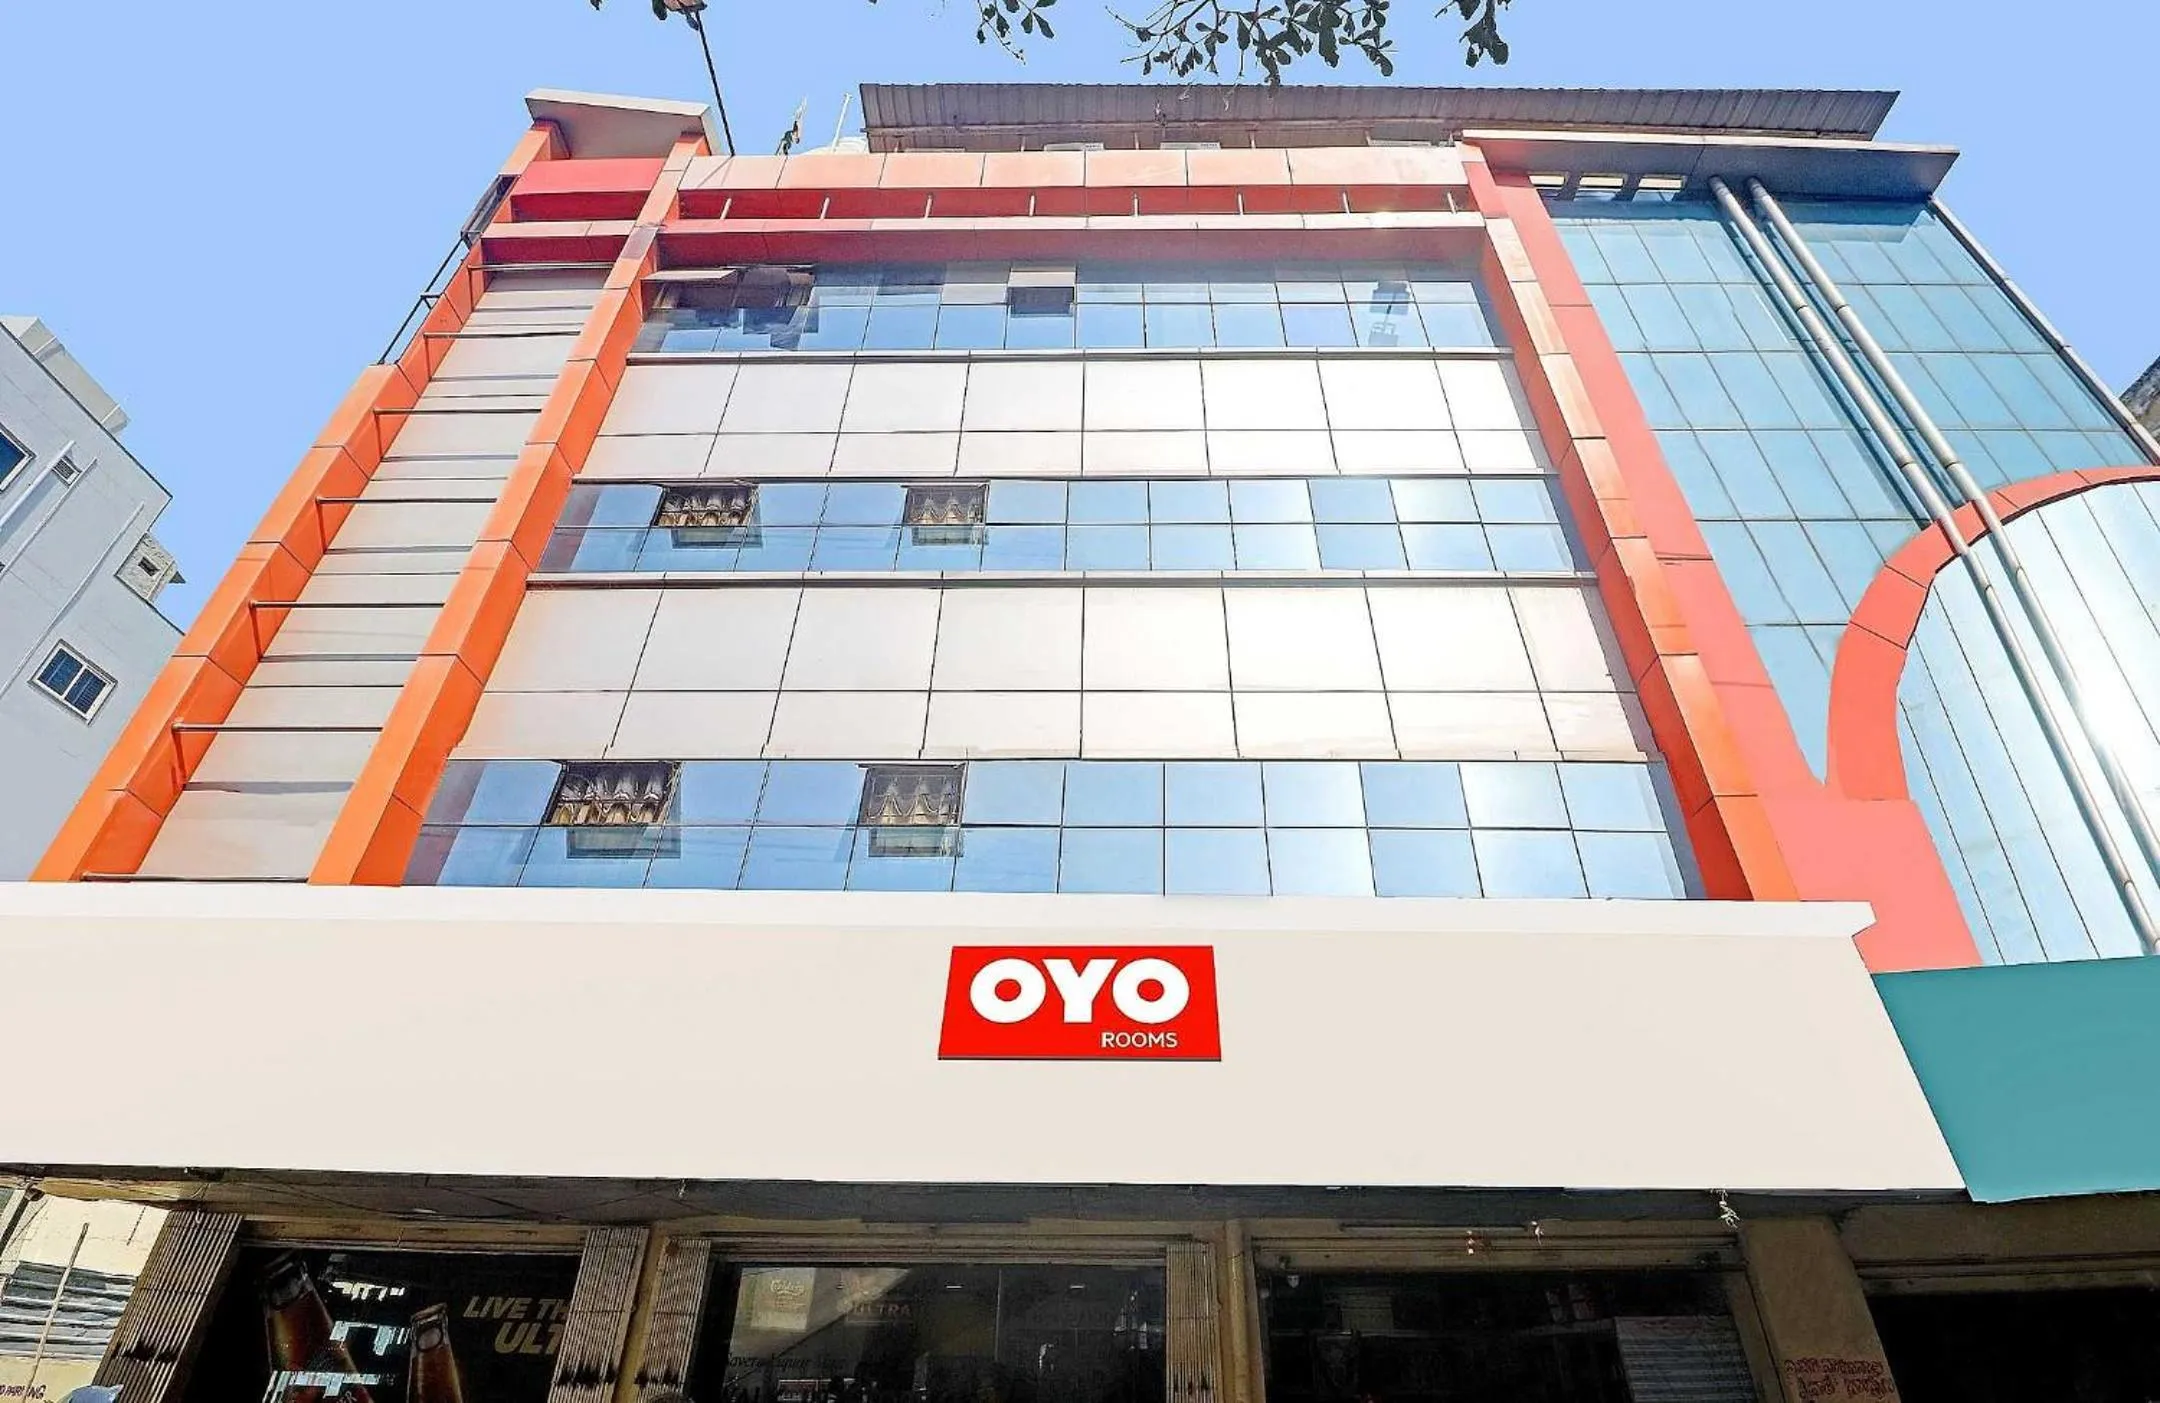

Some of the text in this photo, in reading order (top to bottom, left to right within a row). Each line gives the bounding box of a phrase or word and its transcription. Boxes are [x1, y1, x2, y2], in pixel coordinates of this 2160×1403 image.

[969, 957, 1191, 1024] OYO
[1101, 1031, 1178, 1048] ROOMS
[464, 1297, 532, 1318] LIVE
